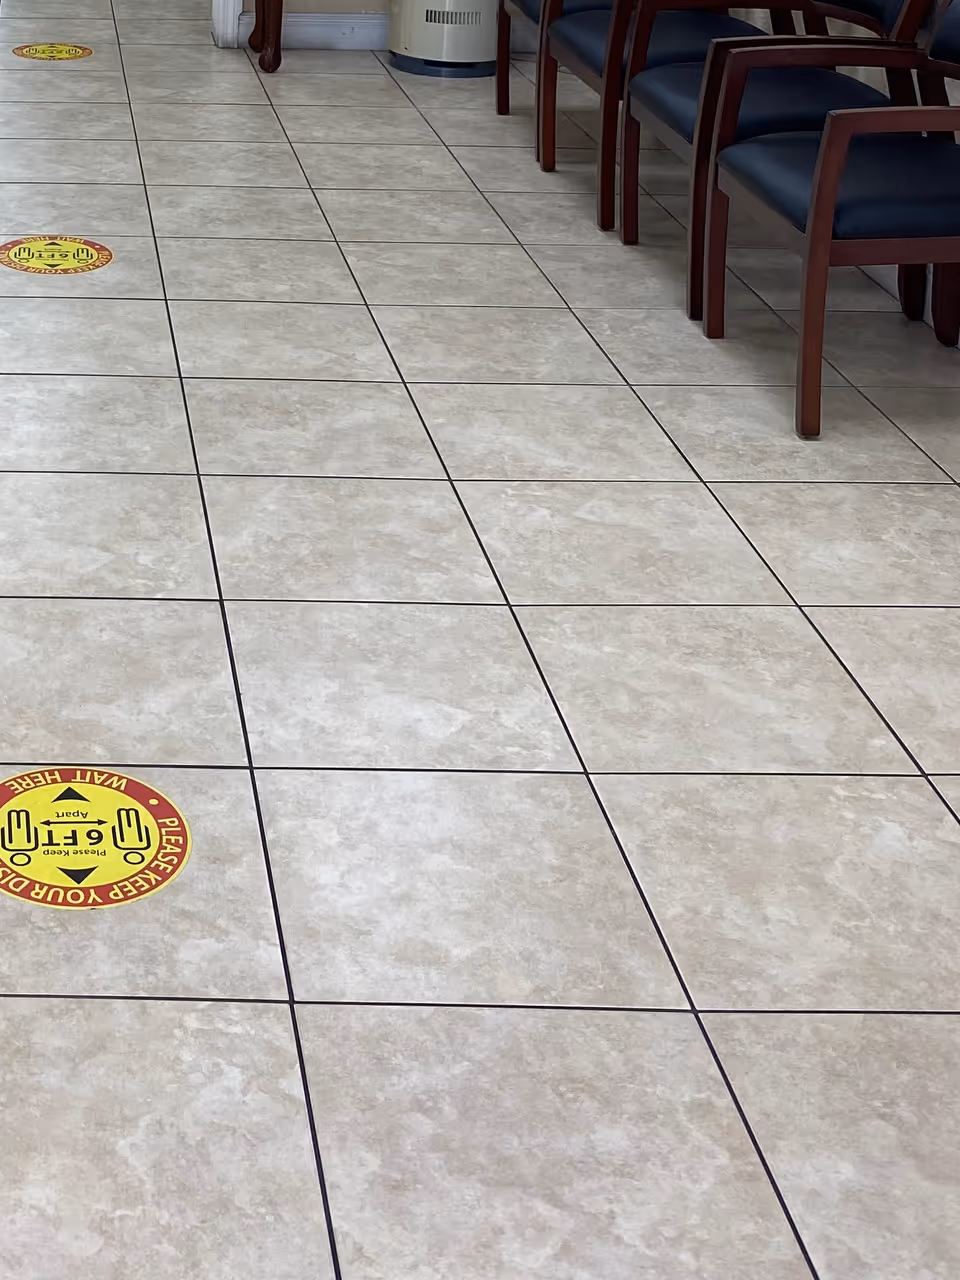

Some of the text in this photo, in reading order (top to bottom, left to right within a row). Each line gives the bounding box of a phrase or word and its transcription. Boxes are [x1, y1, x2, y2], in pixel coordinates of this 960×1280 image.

[5, 770, 128, 794] WAIT HERE
[55, 811, 89, 819] Apart
[42, 849, 107, 857] Please Keep
[151, 817, 184, 875] PLEASE
[30, 884, 103, 904] YOUR
[109, 870, 162, 900] KEEP
